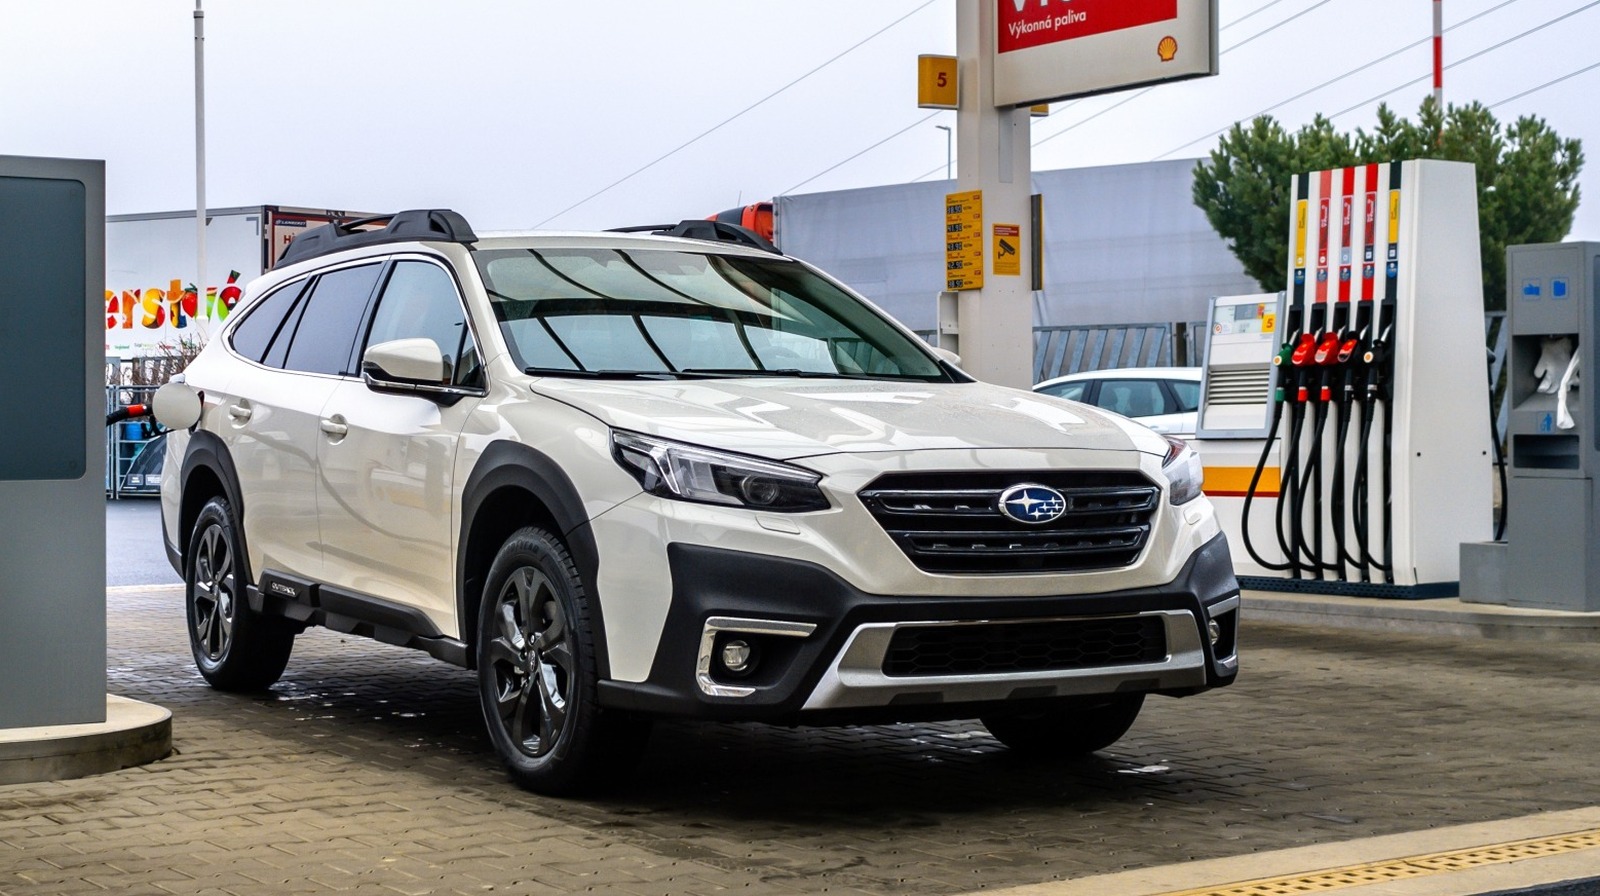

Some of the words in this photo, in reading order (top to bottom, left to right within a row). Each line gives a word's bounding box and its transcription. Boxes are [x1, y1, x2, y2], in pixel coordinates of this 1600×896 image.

[1008, 15, 1052, 39] Výkonná
[1054, 9, 1087, 31] paliva
[937, 72, 948, 88] 5
[1266, 318, 1274, 329] 5
